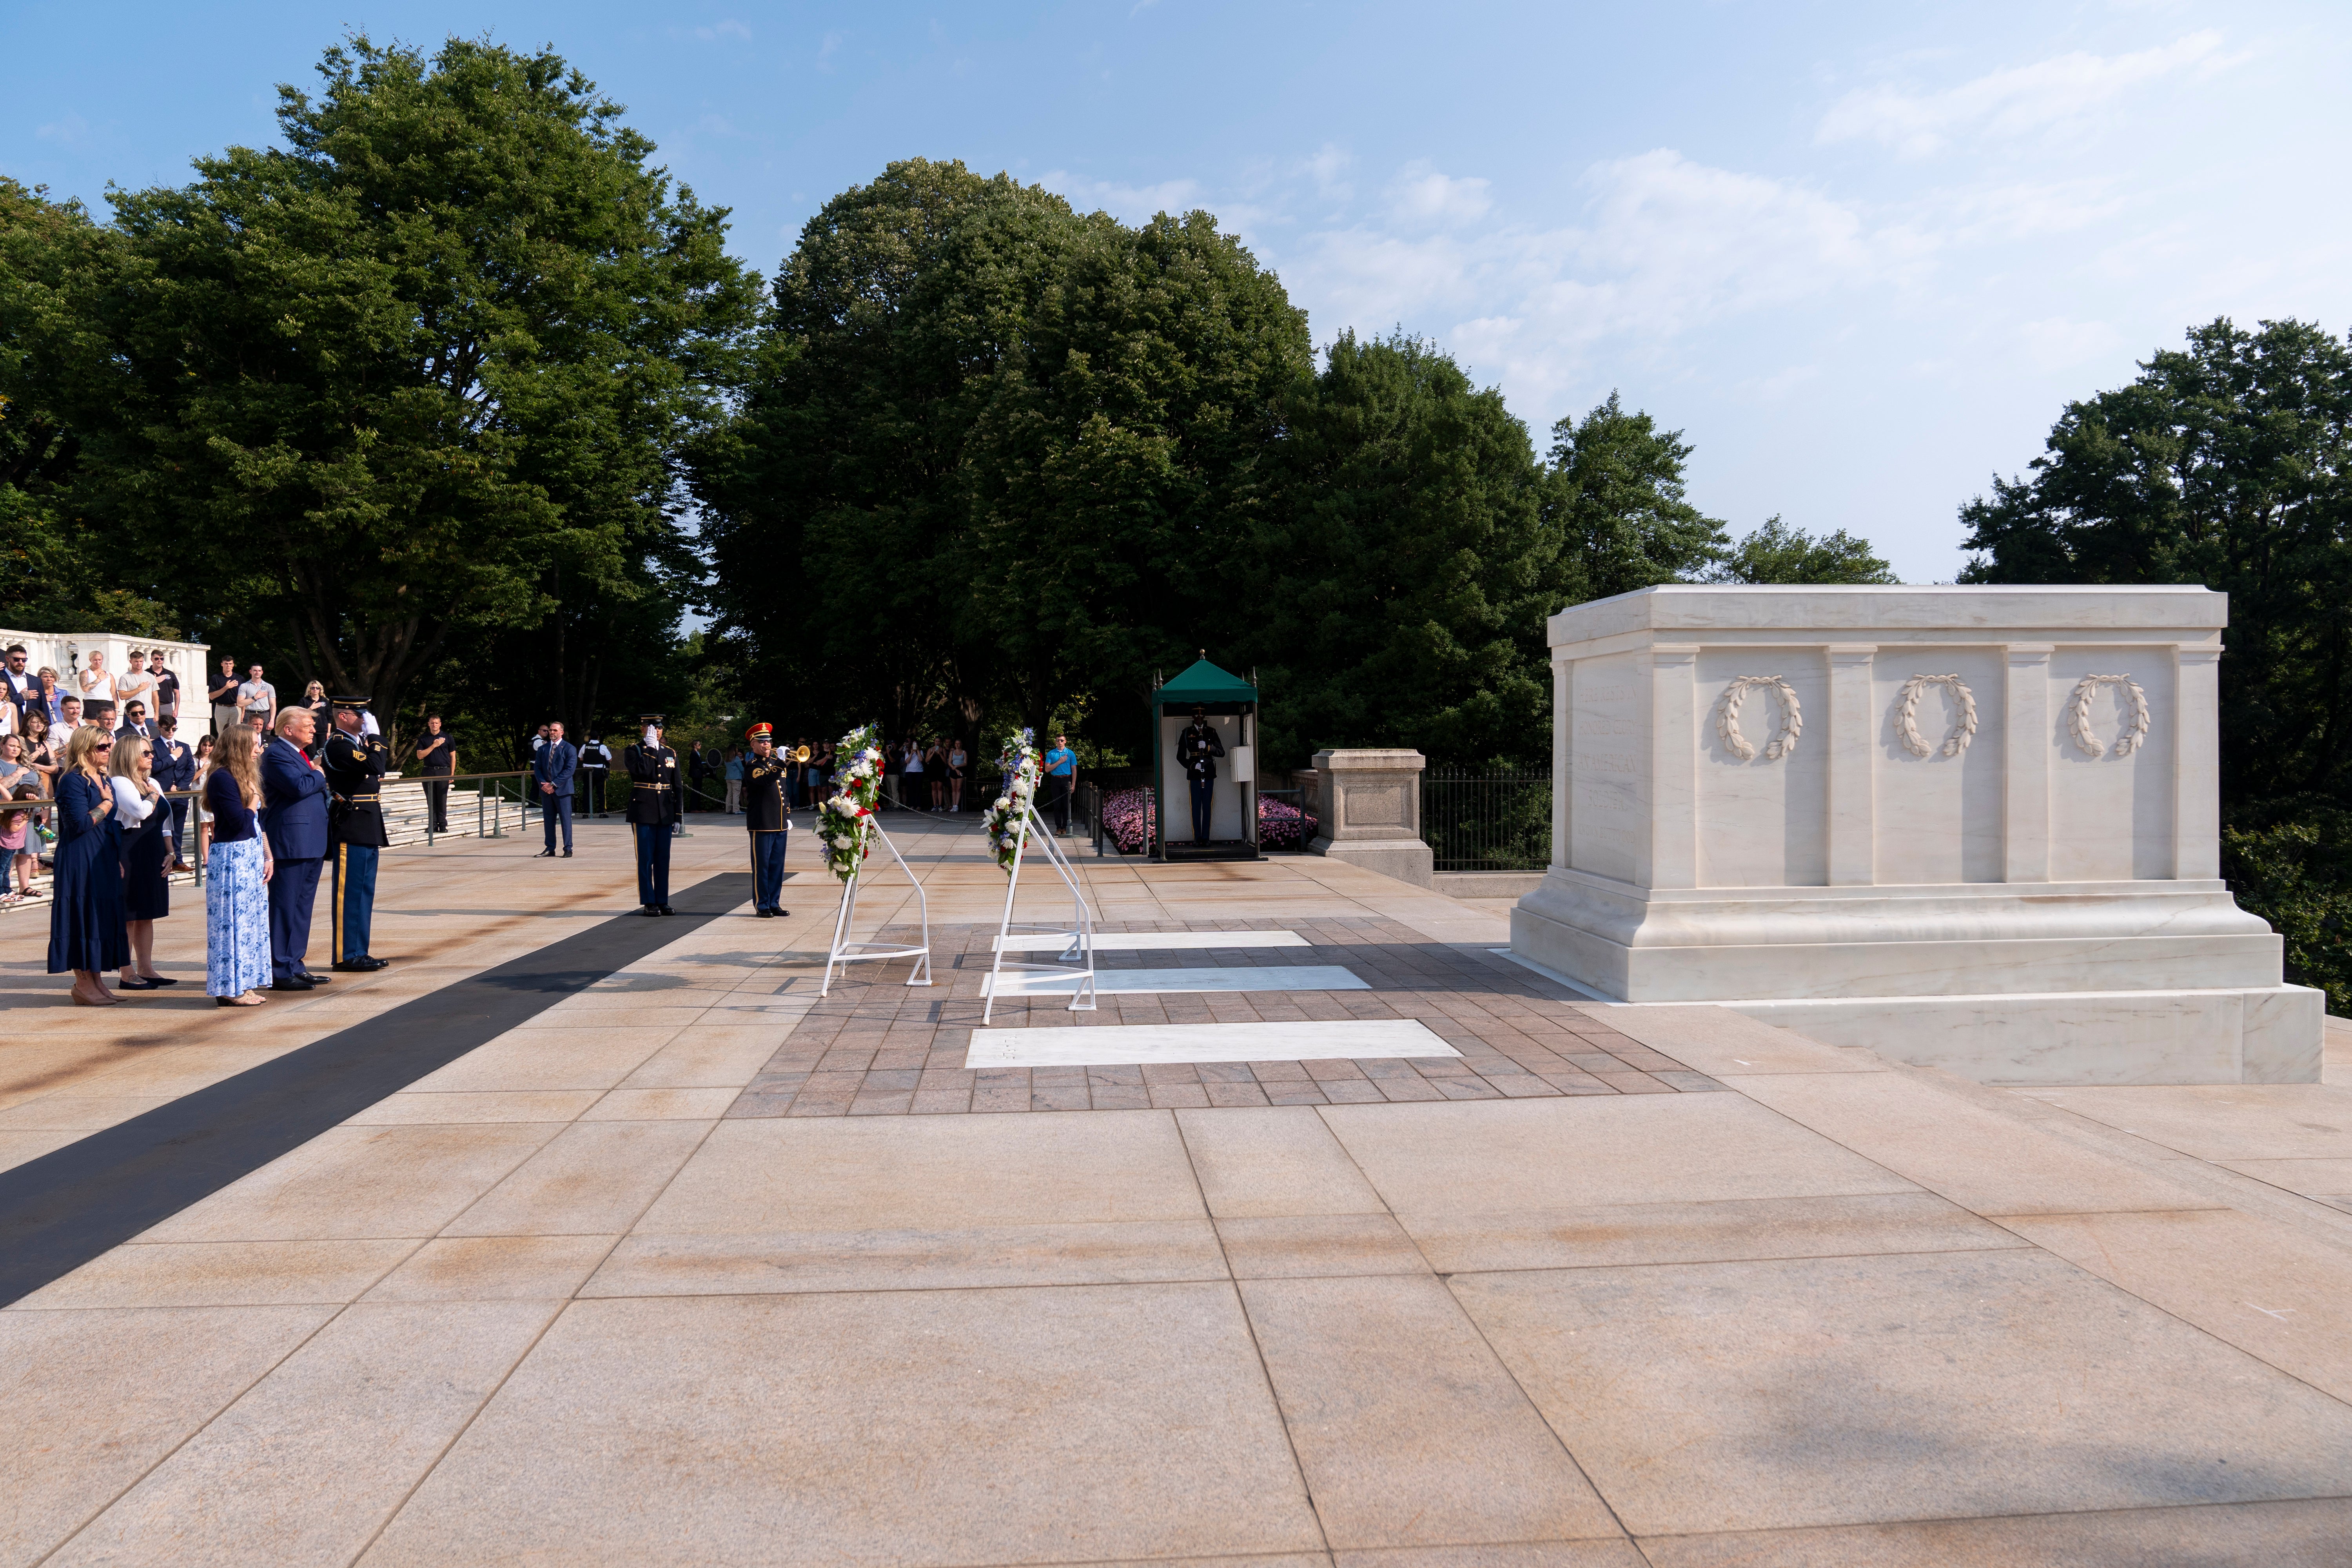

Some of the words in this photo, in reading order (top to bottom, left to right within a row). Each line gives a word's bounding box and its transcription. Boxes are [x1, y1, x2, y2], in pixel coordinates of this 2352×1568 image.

[1579, 688, 1598, 702] HERE
[1601, 685, 1624, 701] RESTS
[1628, 684, 1636, 699] IN
[1579, 720, 1610, 735] HONORED
[1613, 719, 1636, 734] GLORY
[1591, 754, 1637, 772] AMERICAN
[1588, 789, 1628, 811] SOLDIER
[1578, 824, 1599, 837] KNOWN
[1622, 830, 1635, 844] GOD
